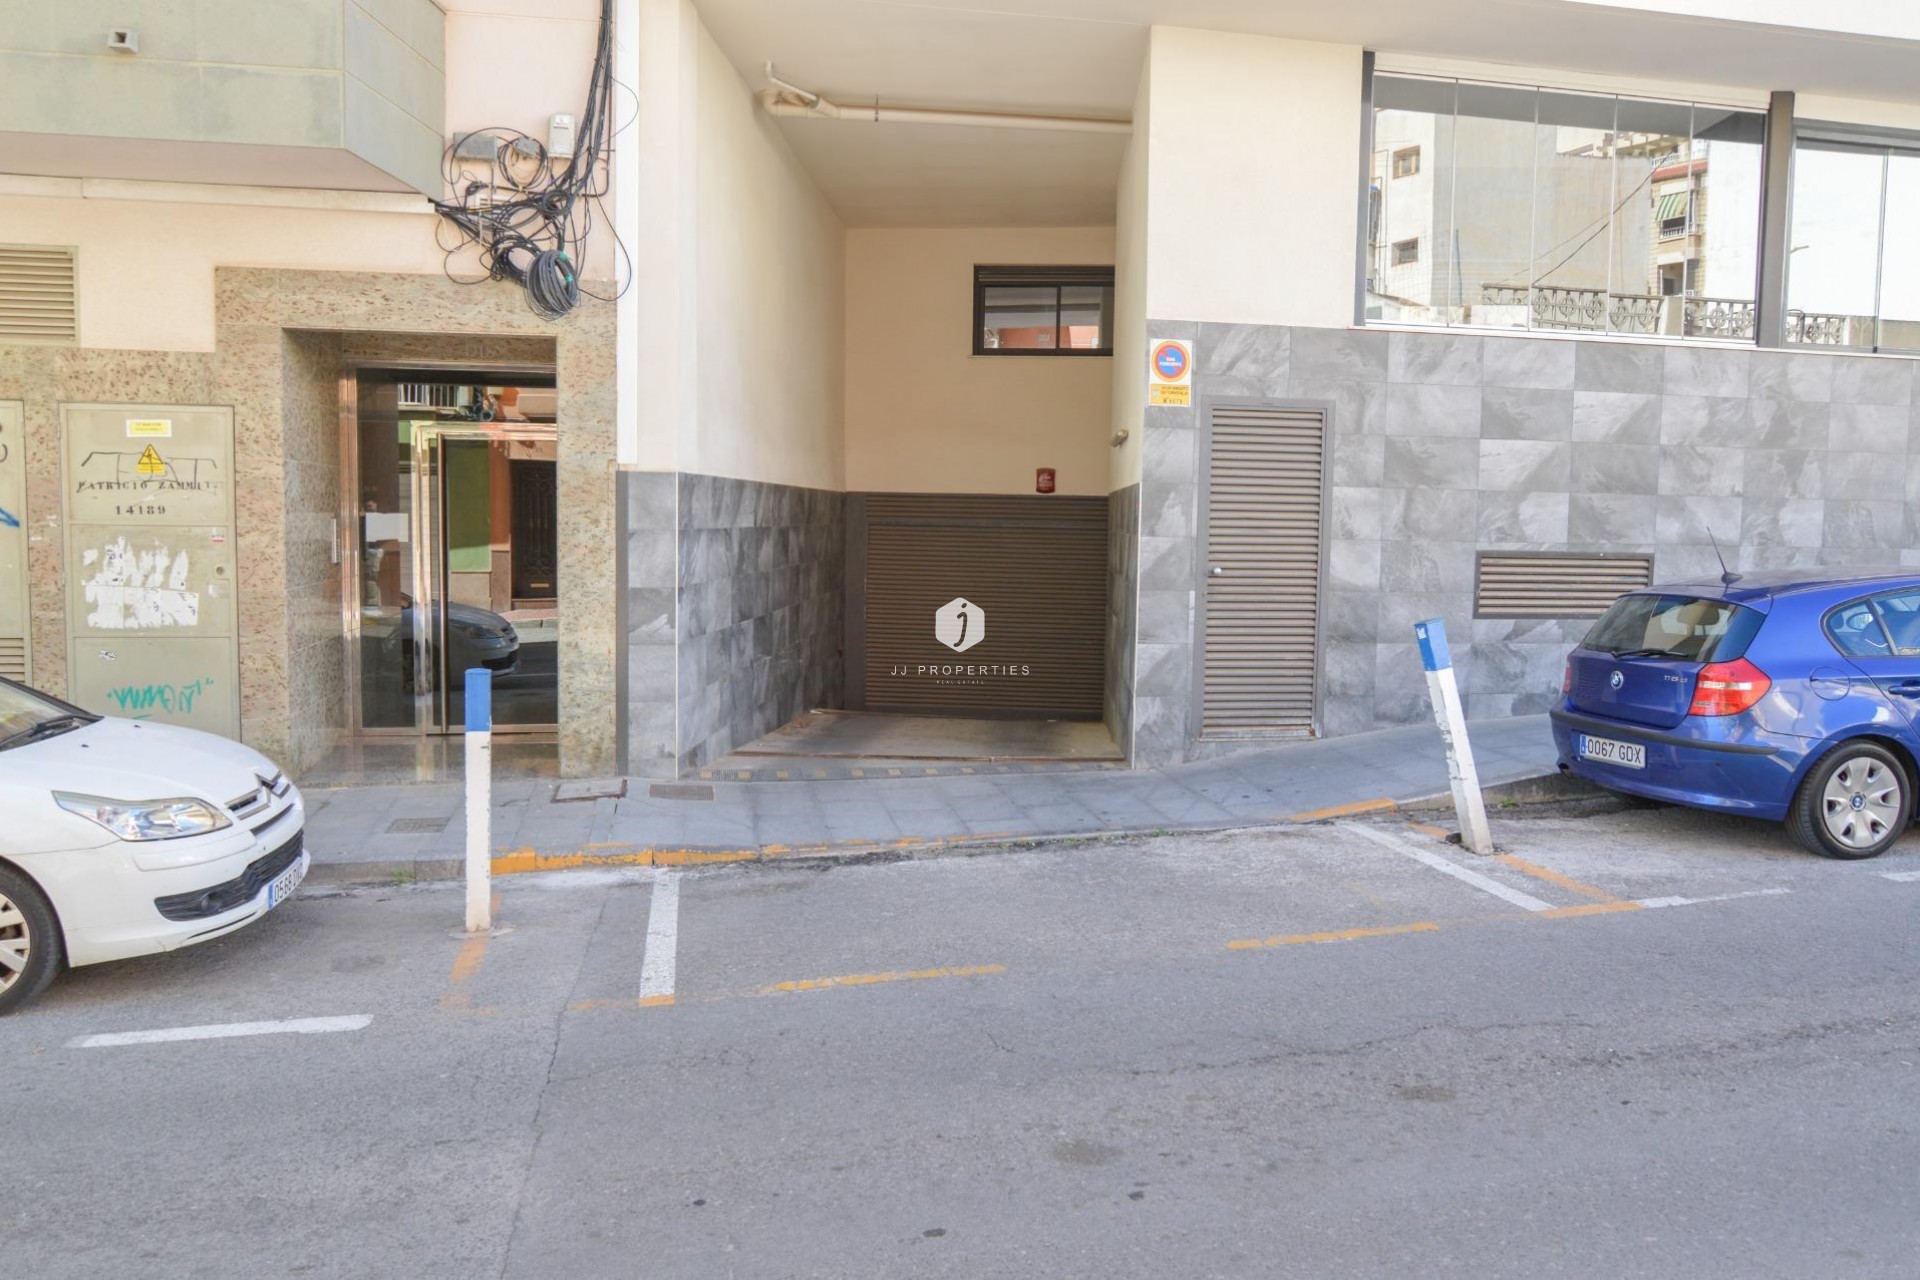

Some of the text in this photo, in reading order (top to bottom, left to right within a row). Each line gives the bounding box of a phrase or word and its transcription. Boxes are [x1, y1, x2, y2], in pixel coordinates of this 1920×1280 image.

[79, 481, 148, 490] PATRICIO
[115, 505, 166, 515] 14189
[1587, 738, 1641, 764] 0067 GDX
